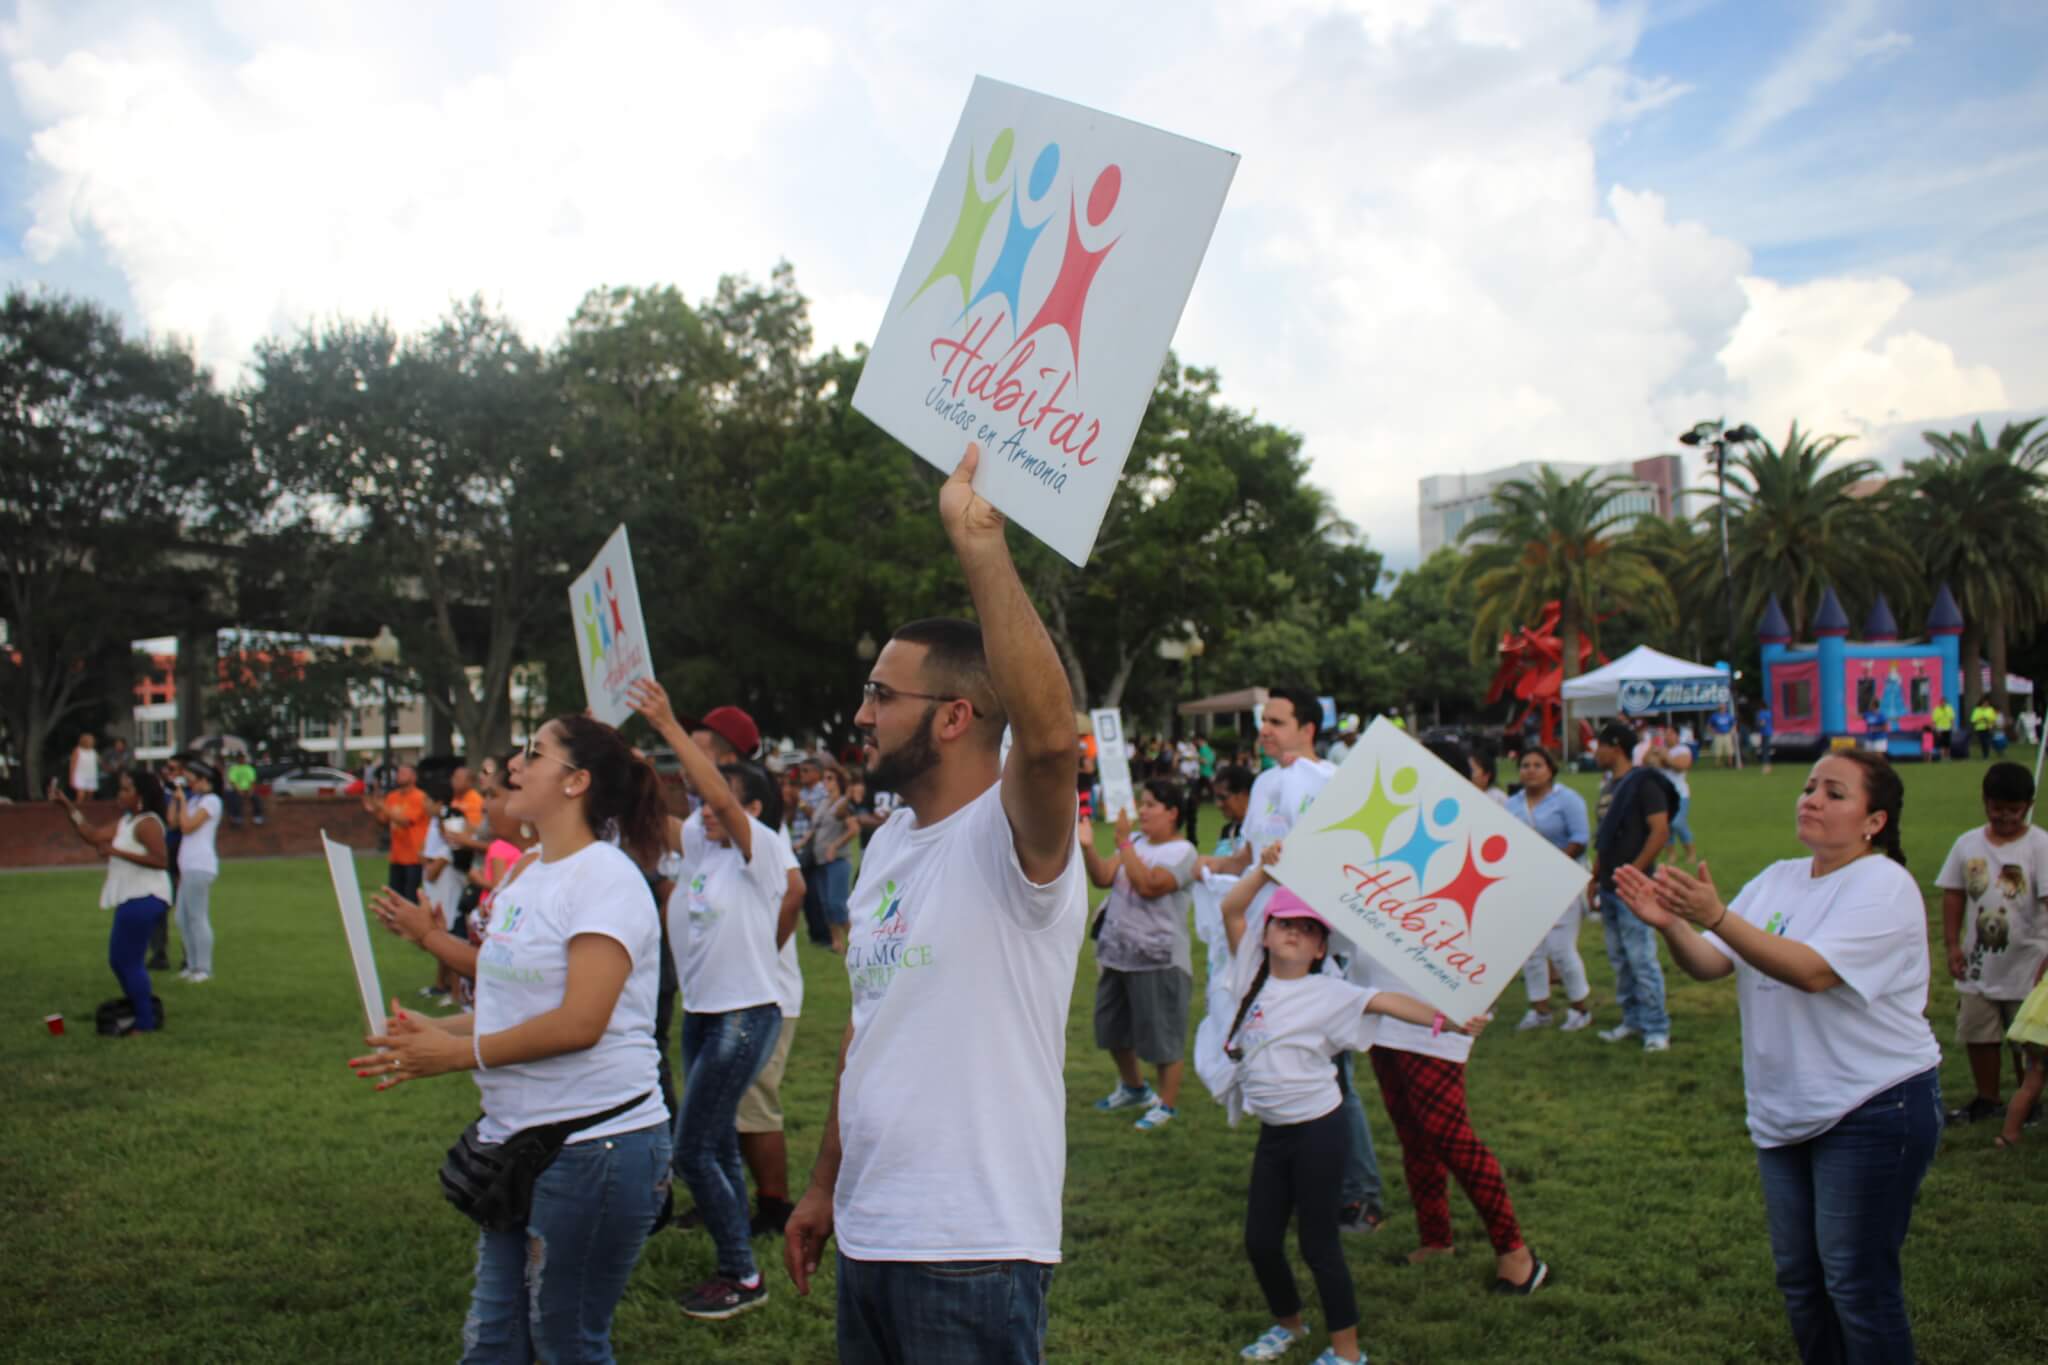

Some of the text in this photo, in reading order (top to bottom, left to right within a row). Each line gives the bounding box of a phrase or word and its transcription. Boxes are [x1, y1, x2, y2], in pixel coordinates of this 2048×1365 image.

[924, 377, 977, 431] Juntos
[976, 424, 998, 449] en
[930, 311, 1101, 466] Habitar
[1343, 864, 1487, 984] Habitar
